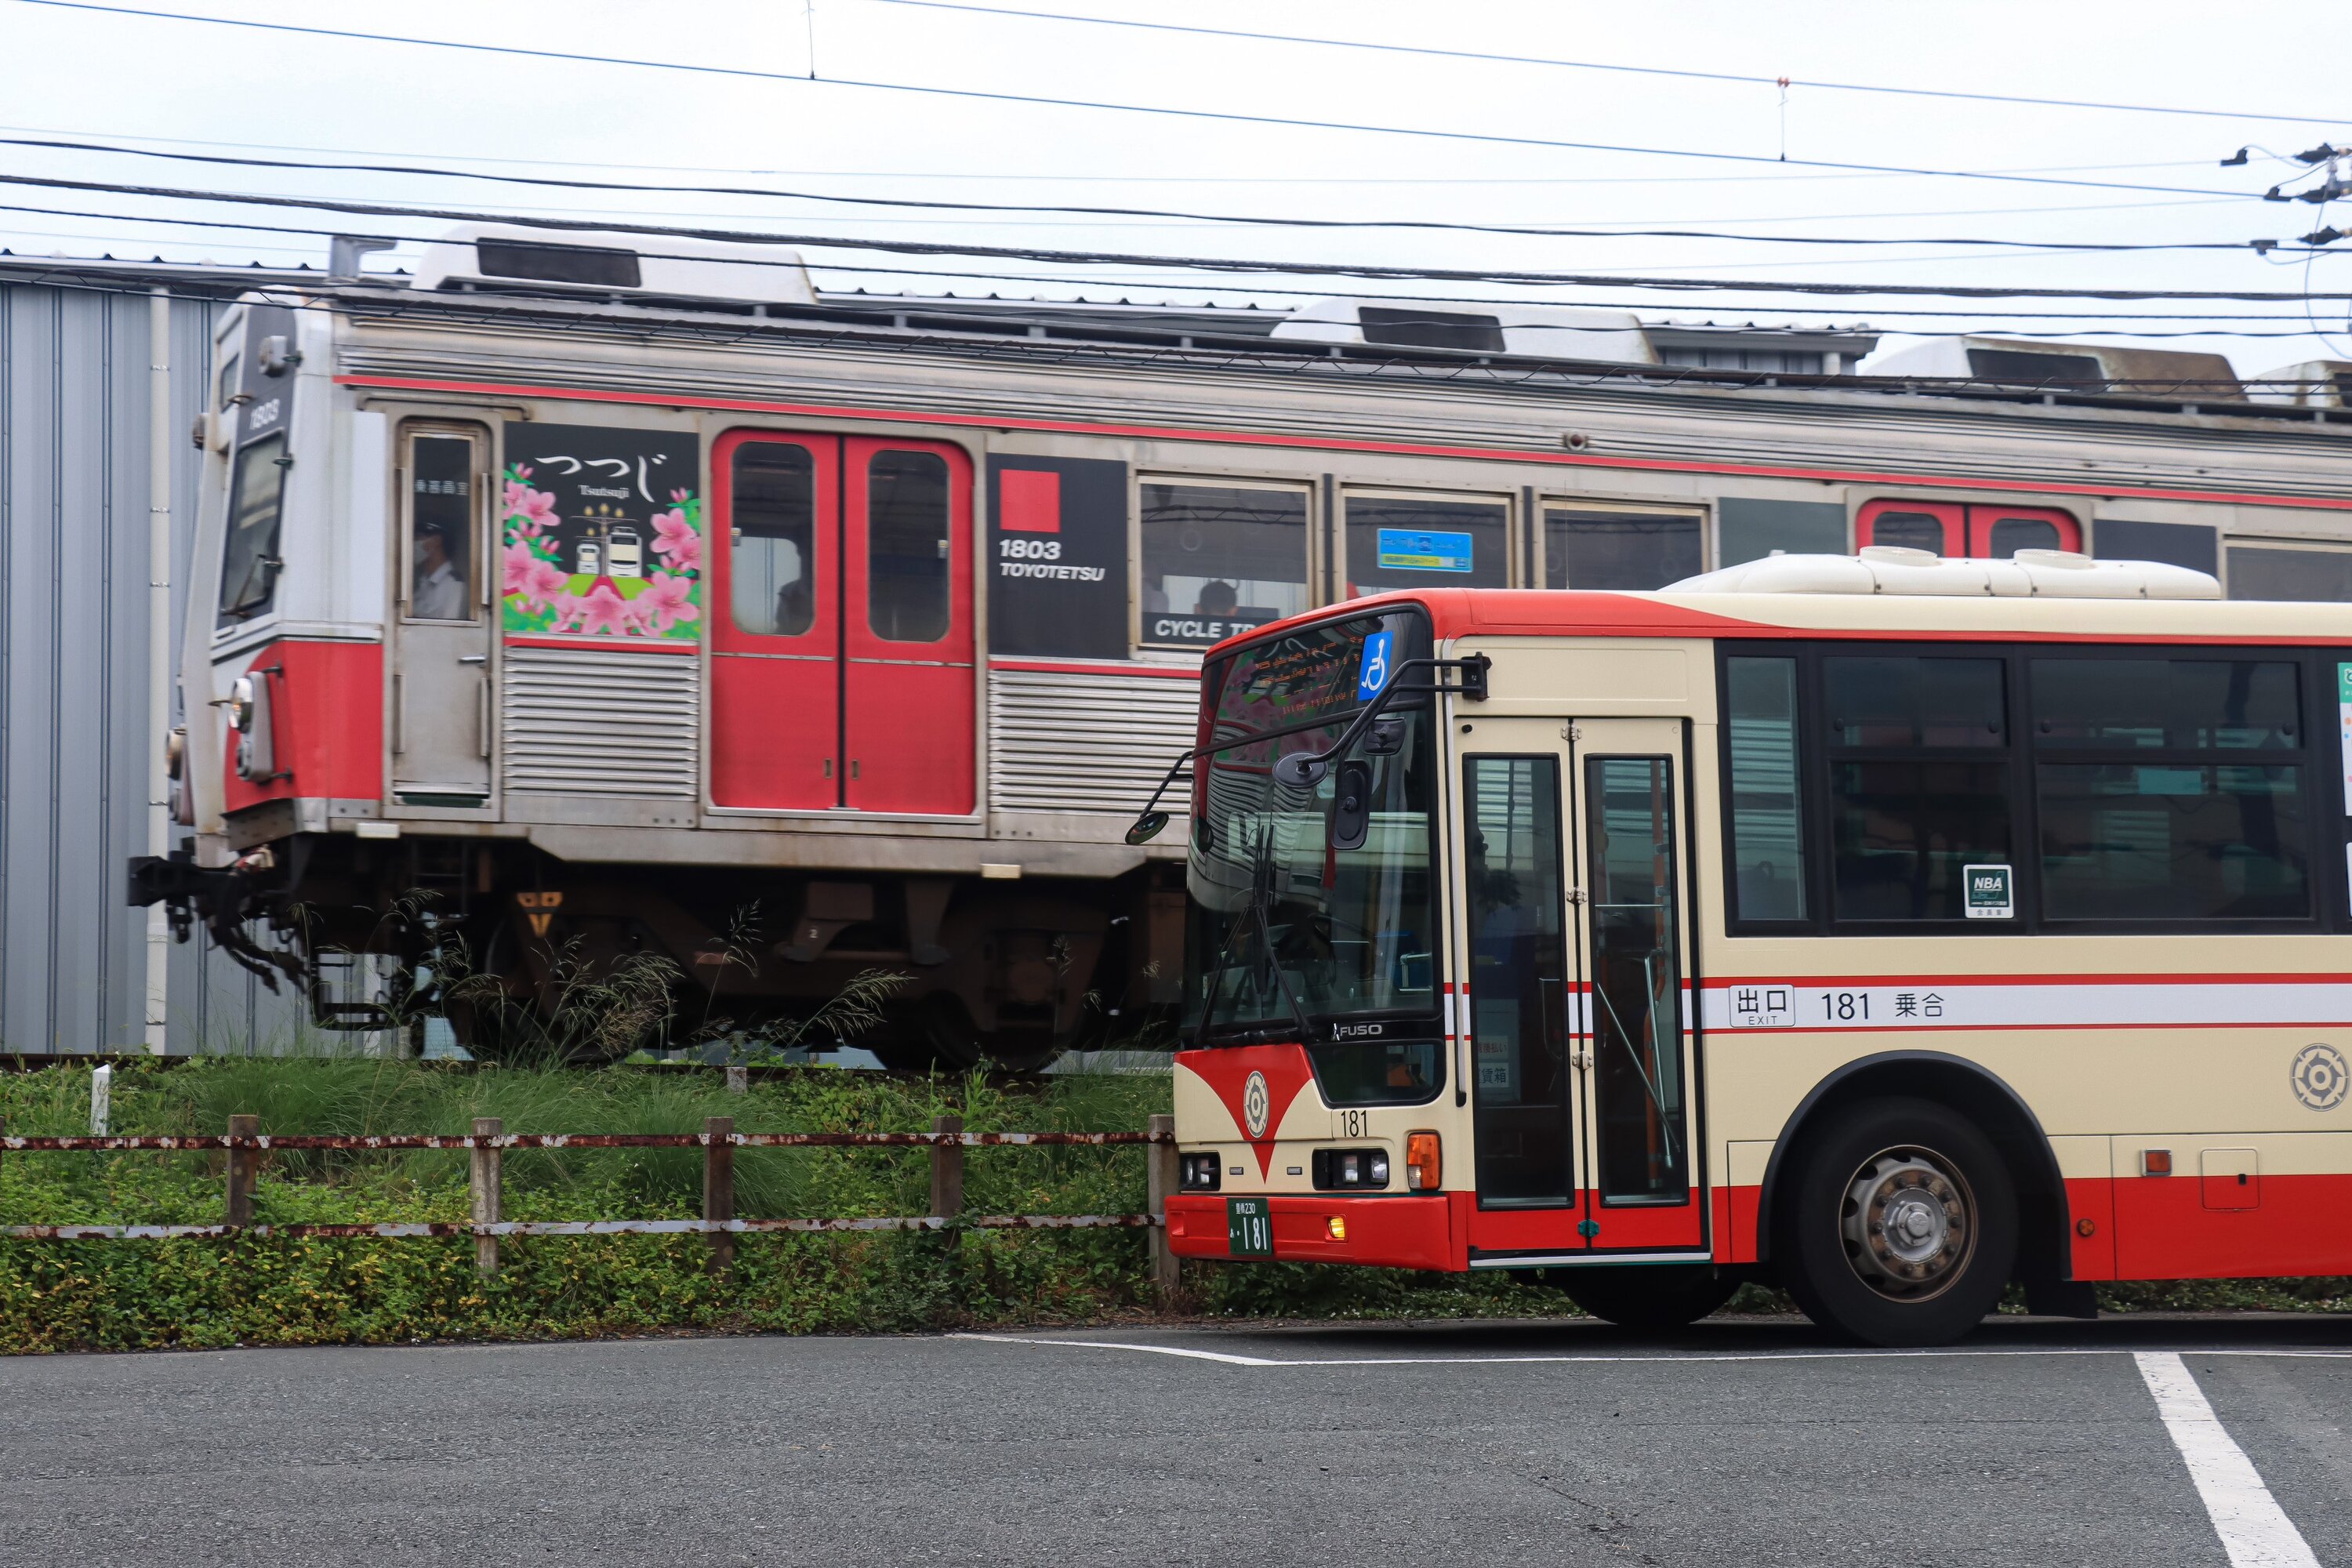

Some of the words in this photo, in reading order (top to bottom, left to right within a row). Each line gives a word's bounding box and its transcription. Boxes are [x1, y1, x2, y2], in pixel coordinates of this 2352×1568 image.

[534, 453, 667, 503] つつじ
[577, 485, 630, 499] Tsutsuji
[999, 539, 1062, 560] 1803
[999, 562, 1105, 581] TOYOTETSU
[1154, 619, 1222, 638] CYCLE
[1974, 877, 2002, 889] NBA
[1738, 988, 1787, 1014] 出口
[1821, 993, 1868, 1020] 181
[1895, 993, 1945, 1018] 乗合
[1340, 1024, 1383, 1036] FUSO
[1748, 1016, 1777, 1025] EXIT
[1479, 1067, 1506, 1084] 賃箱
[1341, 1109, 1367, 1138] 181
